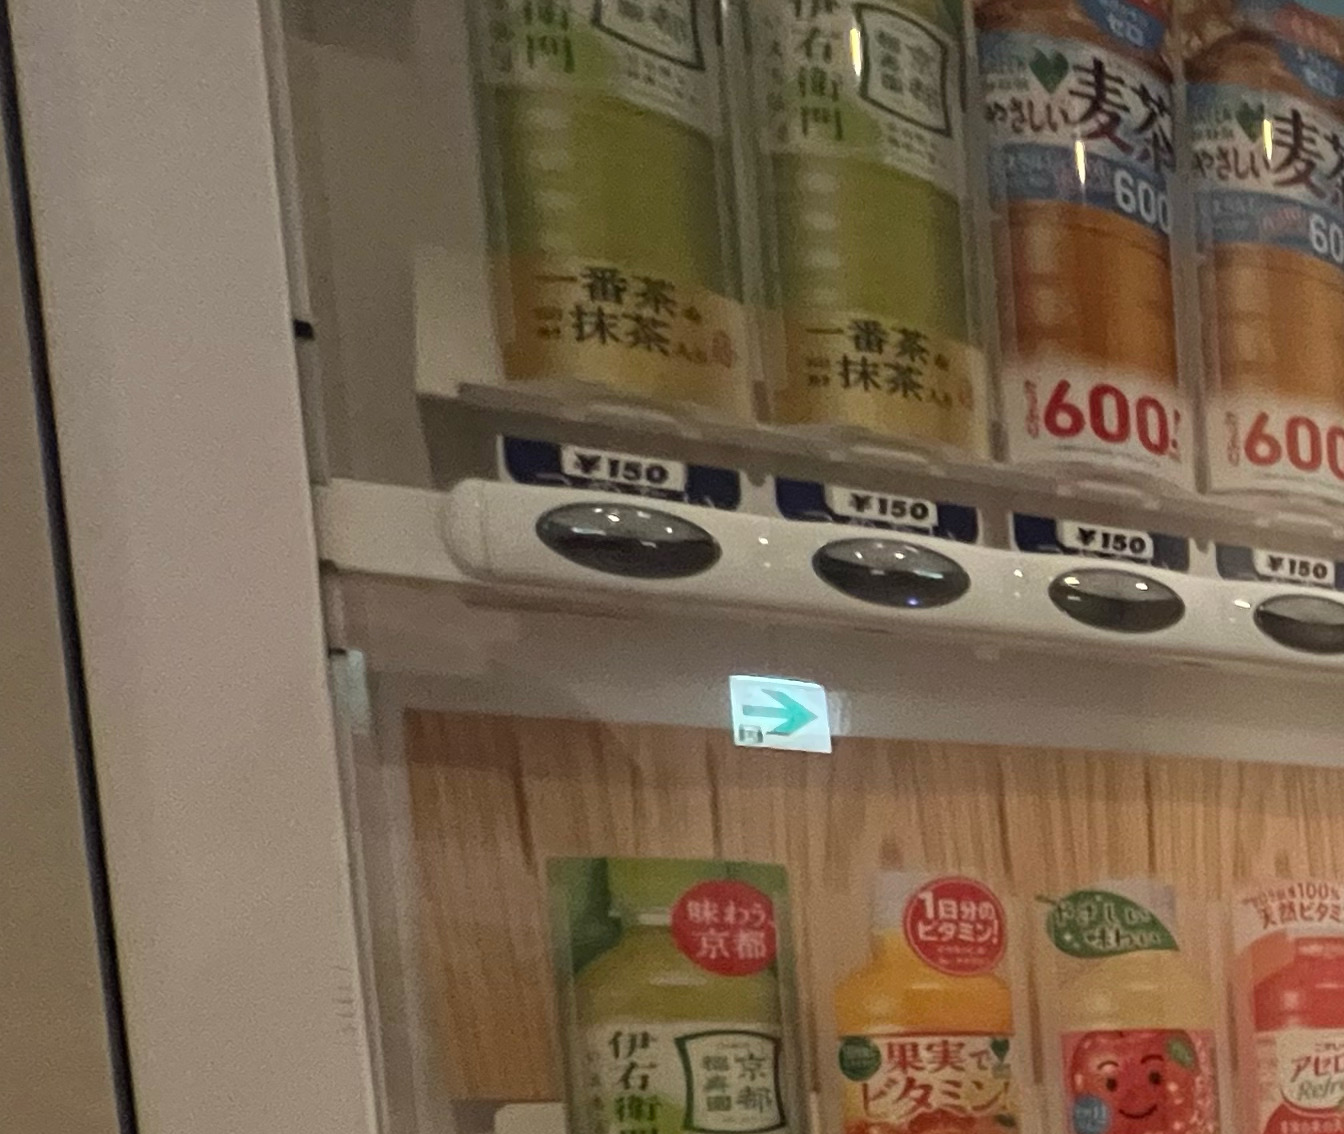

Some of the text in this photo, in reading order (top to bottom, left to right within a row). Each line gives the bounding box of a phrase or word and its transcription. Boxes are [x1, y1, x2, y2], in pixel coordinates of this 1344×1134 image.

[575, 452, 669, 486] ¥150
[849, 493, 930, 523] ¥150
[1077, 526, 1148, 555] ¥150
[1267, 554, 1330, 581] ¥150
[918, 889, 997, 922] 1日分の
[886, 1039, 992, 1074] 果実で
